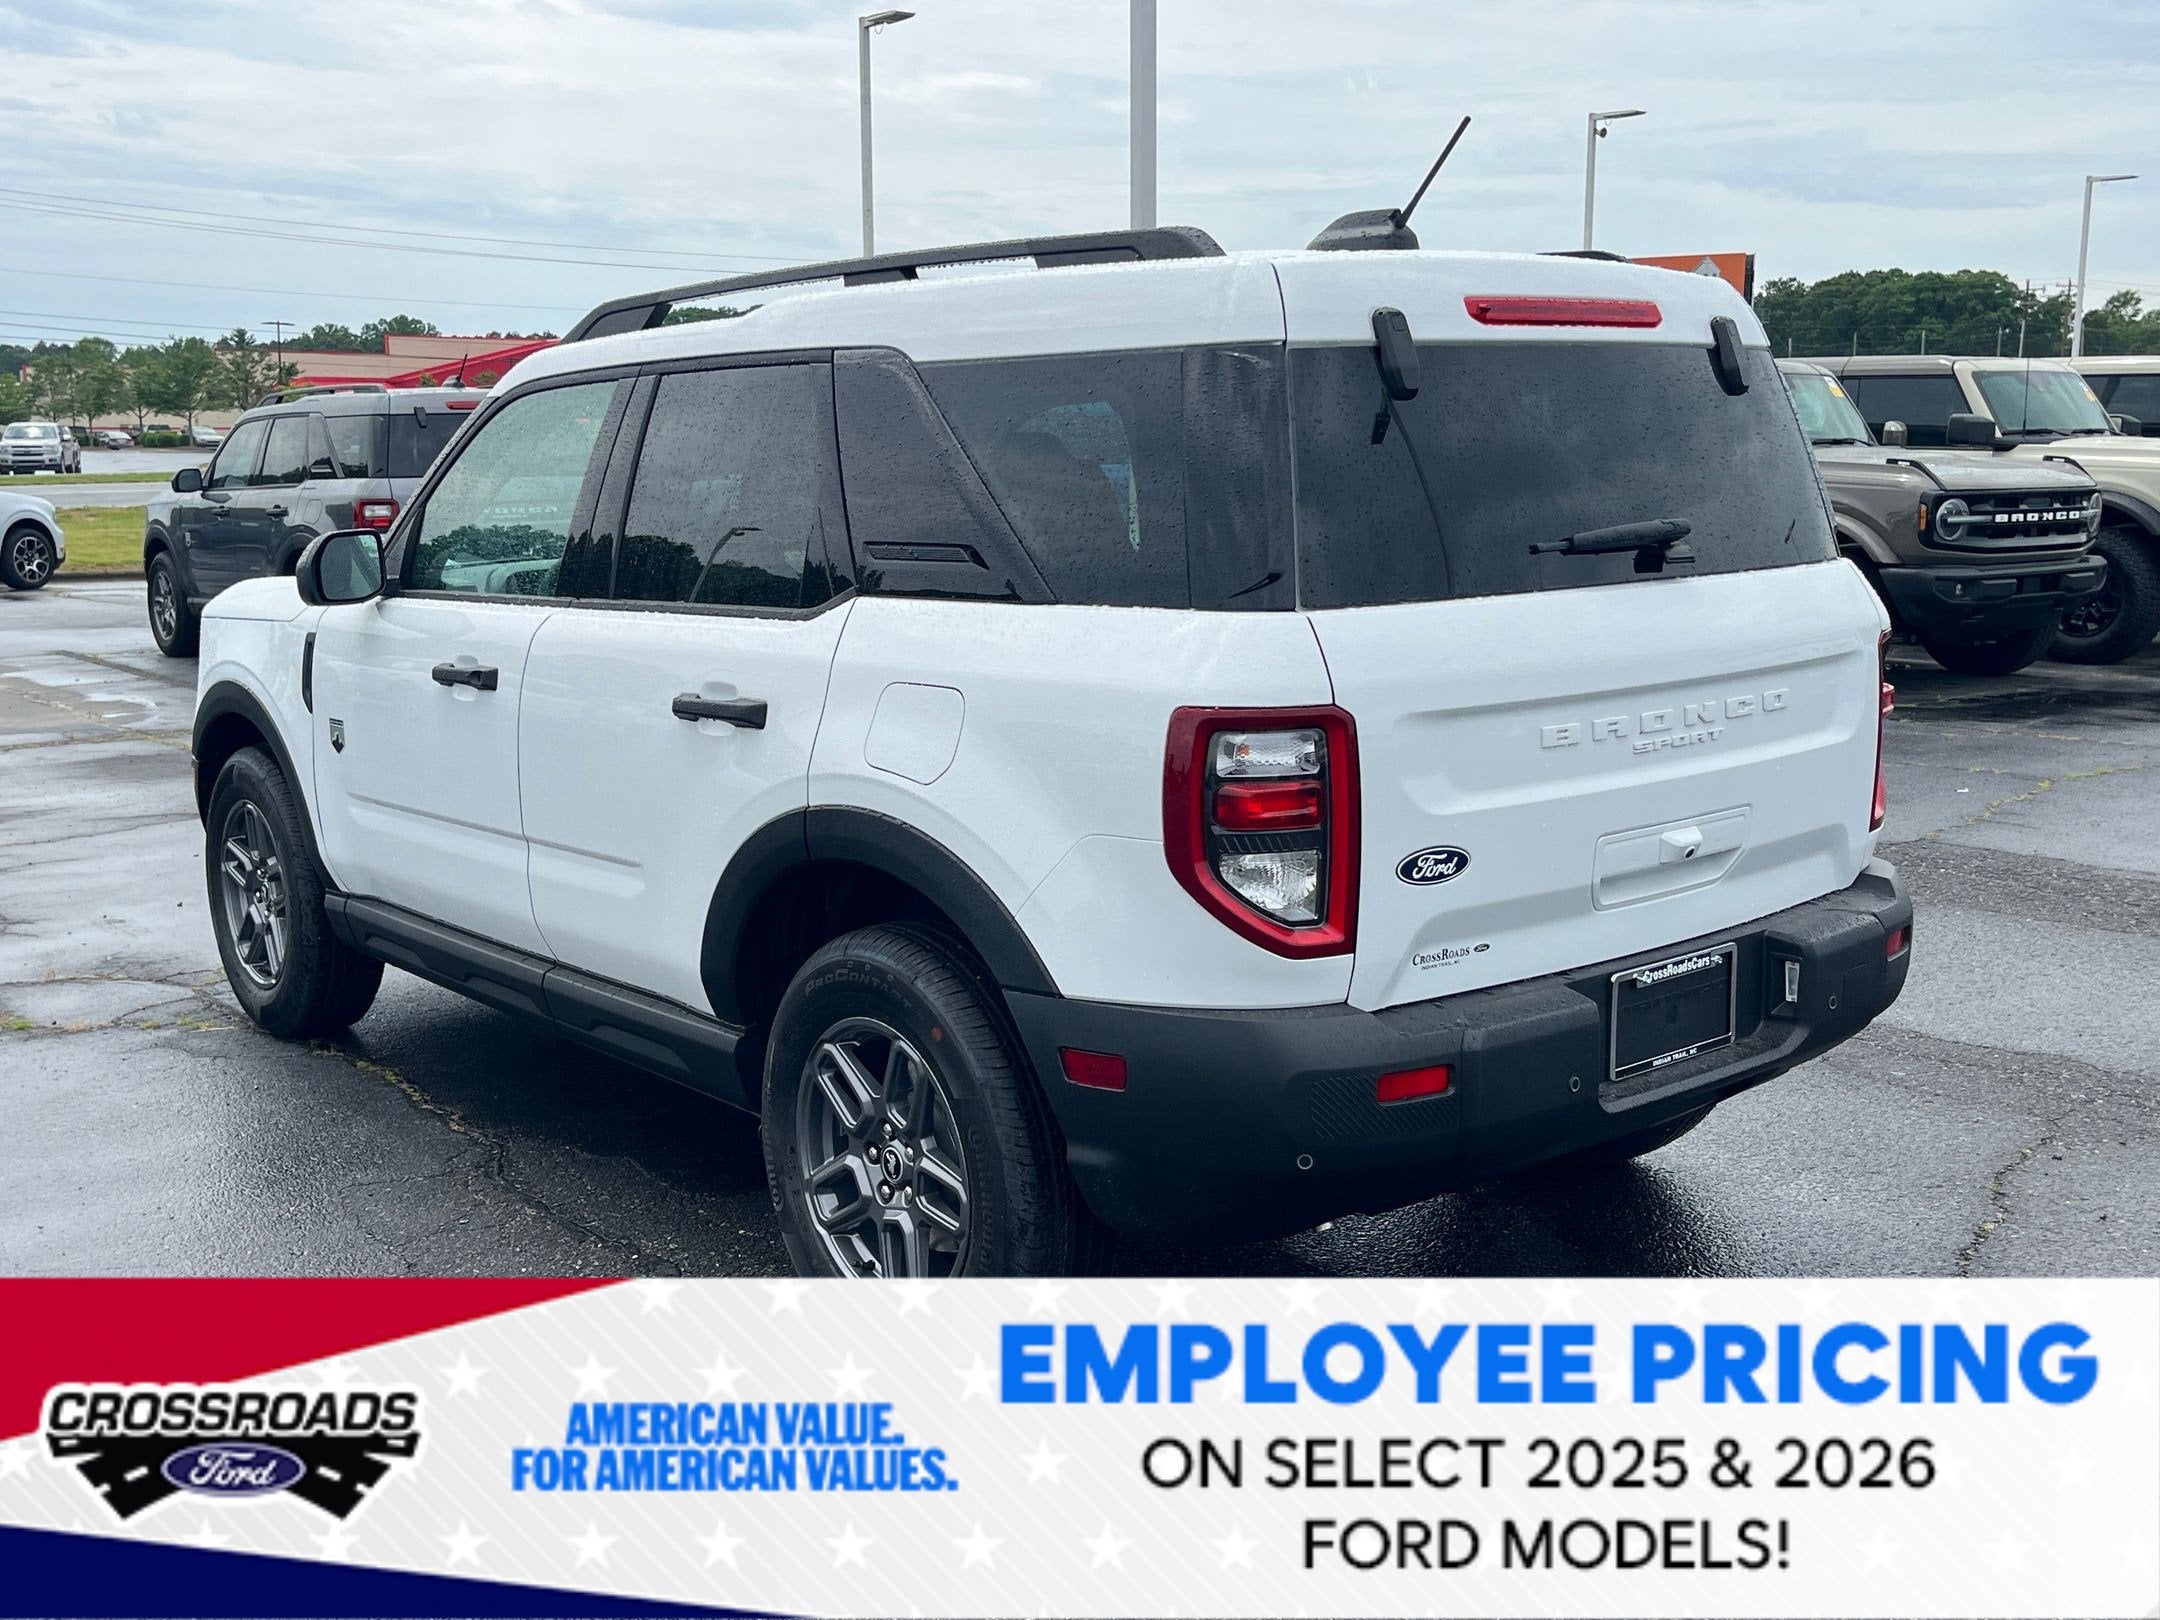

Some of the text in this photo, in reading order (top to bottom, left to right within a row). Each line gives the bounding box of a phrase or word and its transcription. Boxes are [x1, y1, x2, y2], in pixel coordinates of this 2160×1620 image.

[1995, 511, 2080, 523] BRONCO
[1540, 688, 1789, 749] BRONCO
[1632, 727, 1724, 755] SPORT
